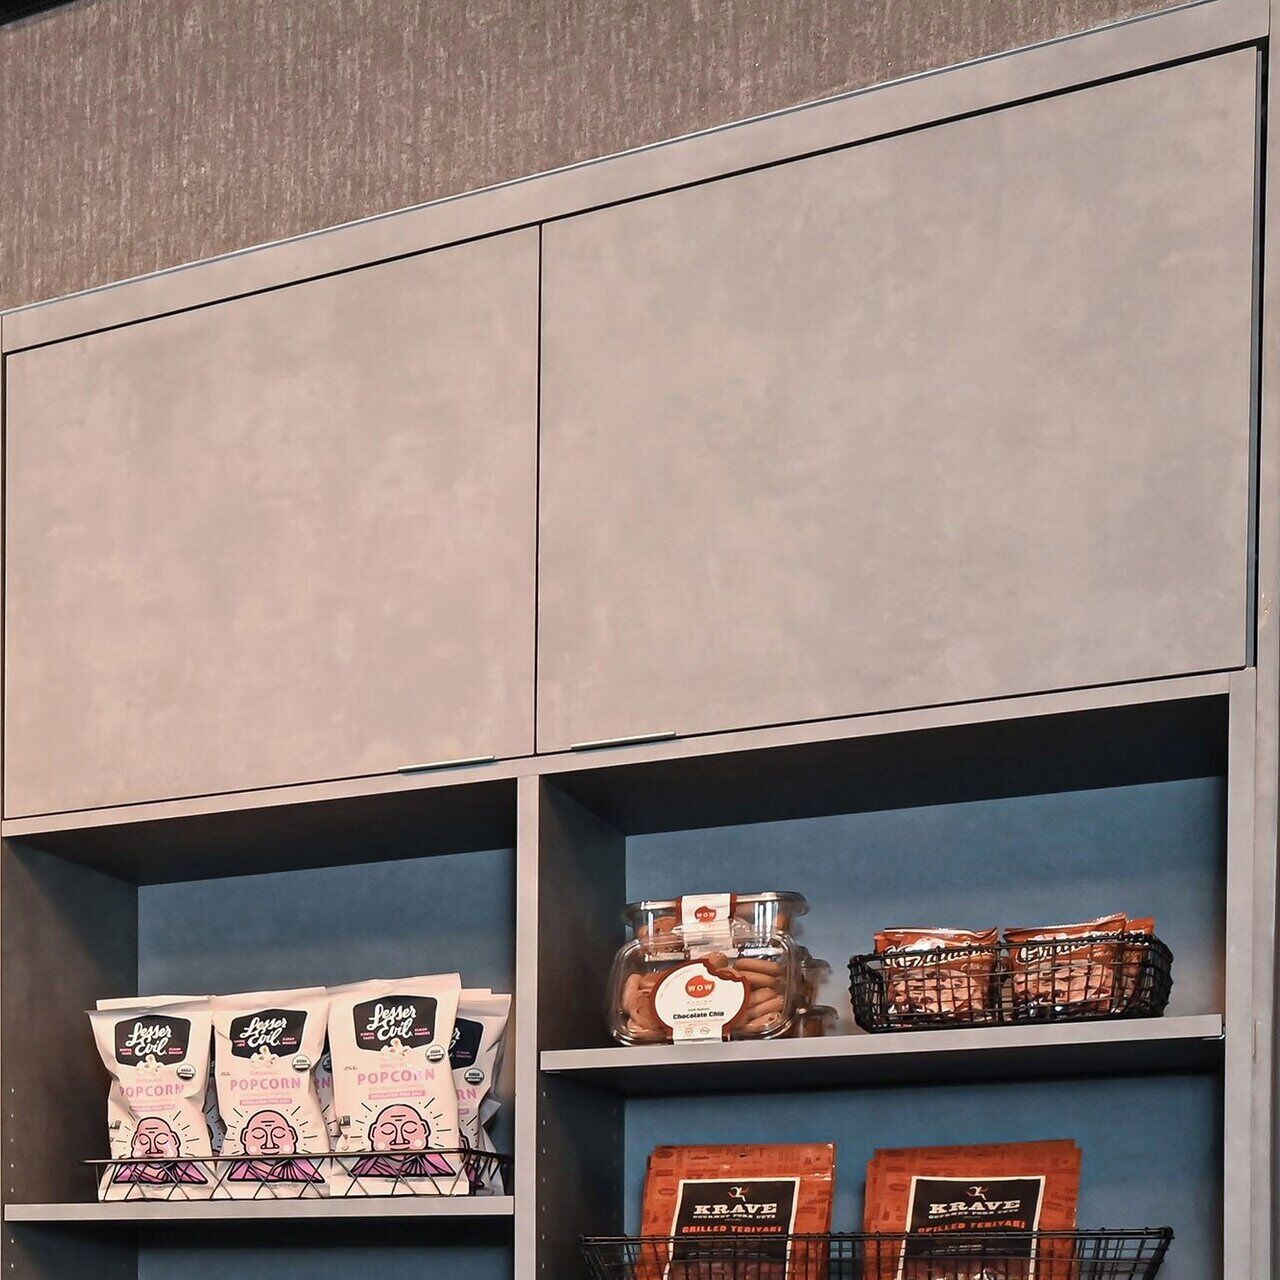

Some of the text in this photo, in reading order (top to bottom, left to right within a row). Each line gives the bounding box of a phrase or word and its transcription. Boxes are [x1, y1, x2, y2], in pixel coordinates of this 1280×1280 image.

[687, 983, 714, 993] WOW
[366, 1003, 417, 1031] Lesser
[672, 1010, 725, 1020] Chocolate Chip
[125, 1021, 172, 1047] Lesser
[239, 1016, 288, 1039] Lesser
[230, 1077, 301, 1091] POPCORN
[693, 1203, 778, 1215] KRAVE
[929, 1200, 1021, 1214] KRAVE
